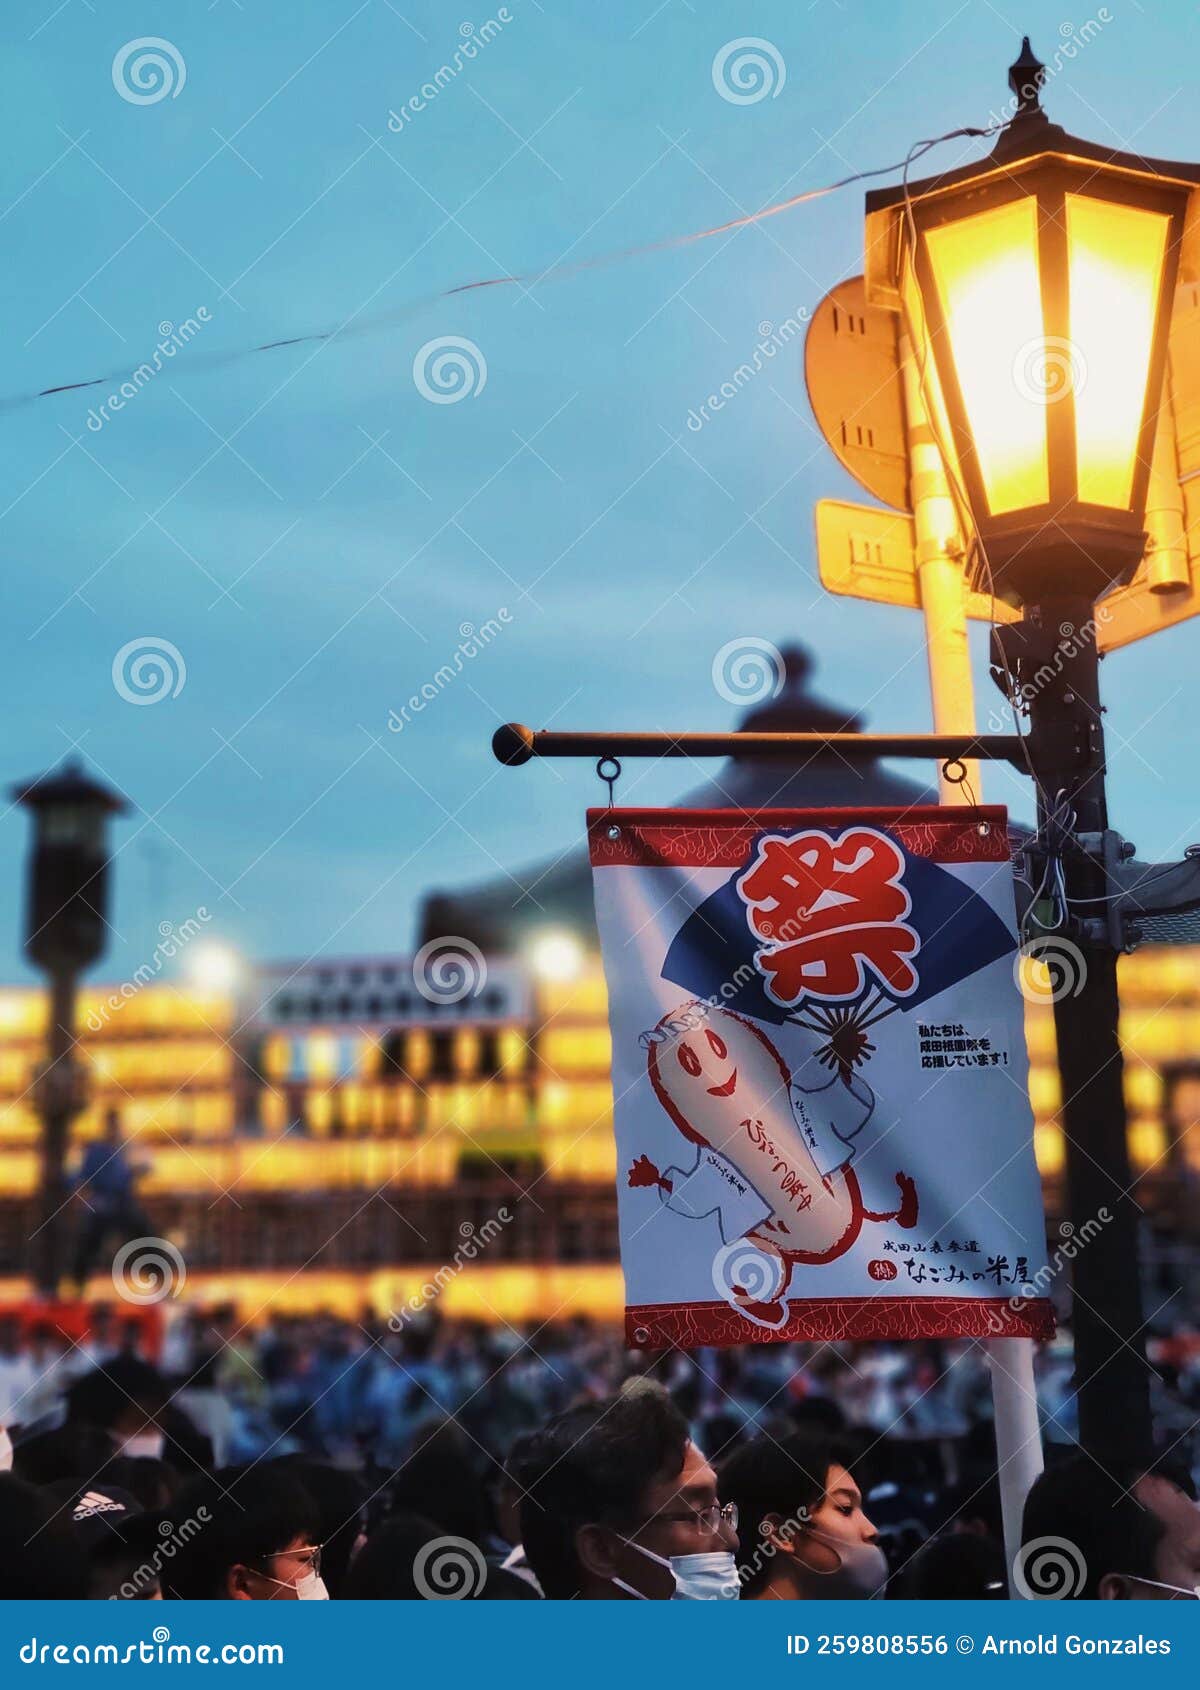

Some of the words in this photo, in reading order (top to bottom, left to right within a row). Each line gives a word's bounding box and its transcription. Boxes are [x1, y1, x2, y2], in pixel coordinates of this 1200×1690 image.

[736, 826, 921, 1004] 祭
[883, 1240, 981, 1254] 成田山表参道
[903, 1255, 1033, 1286] なごみの米屋
[73, 1503, 126, 1521] adidas
